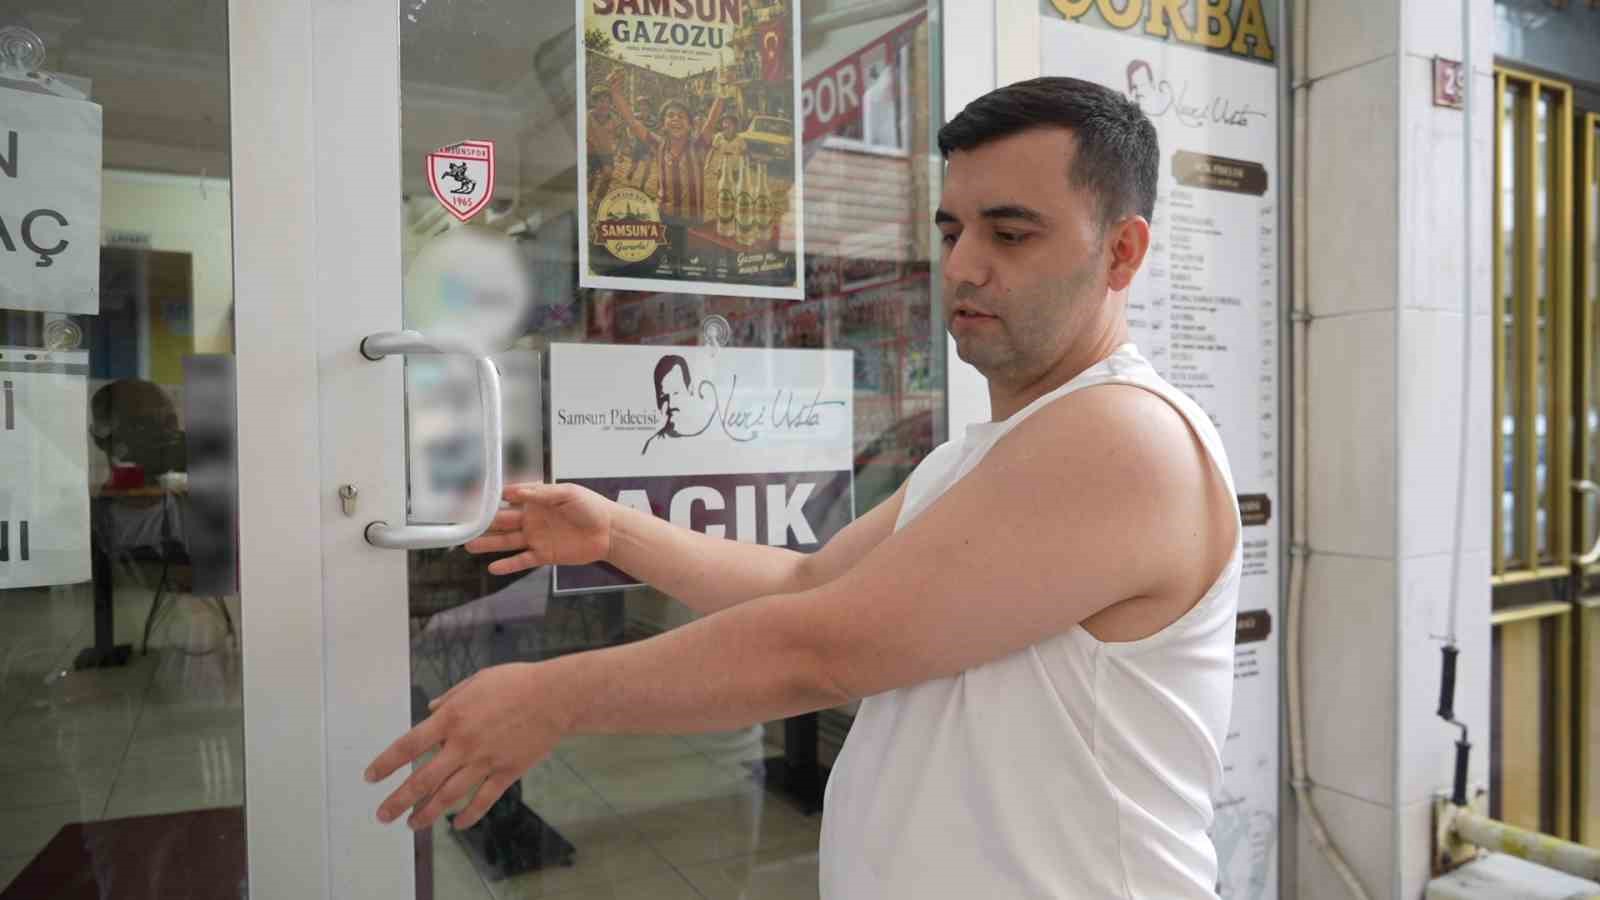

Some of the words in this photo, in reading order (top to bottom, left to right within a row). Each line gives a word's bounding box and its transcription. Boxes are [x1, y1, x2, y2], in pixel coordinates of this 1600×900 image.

[612, 19, 725, 49] GAZOZU
[558, 408, 606, 425] Samsun
[610, 408, 658, 425] Pidecisi
